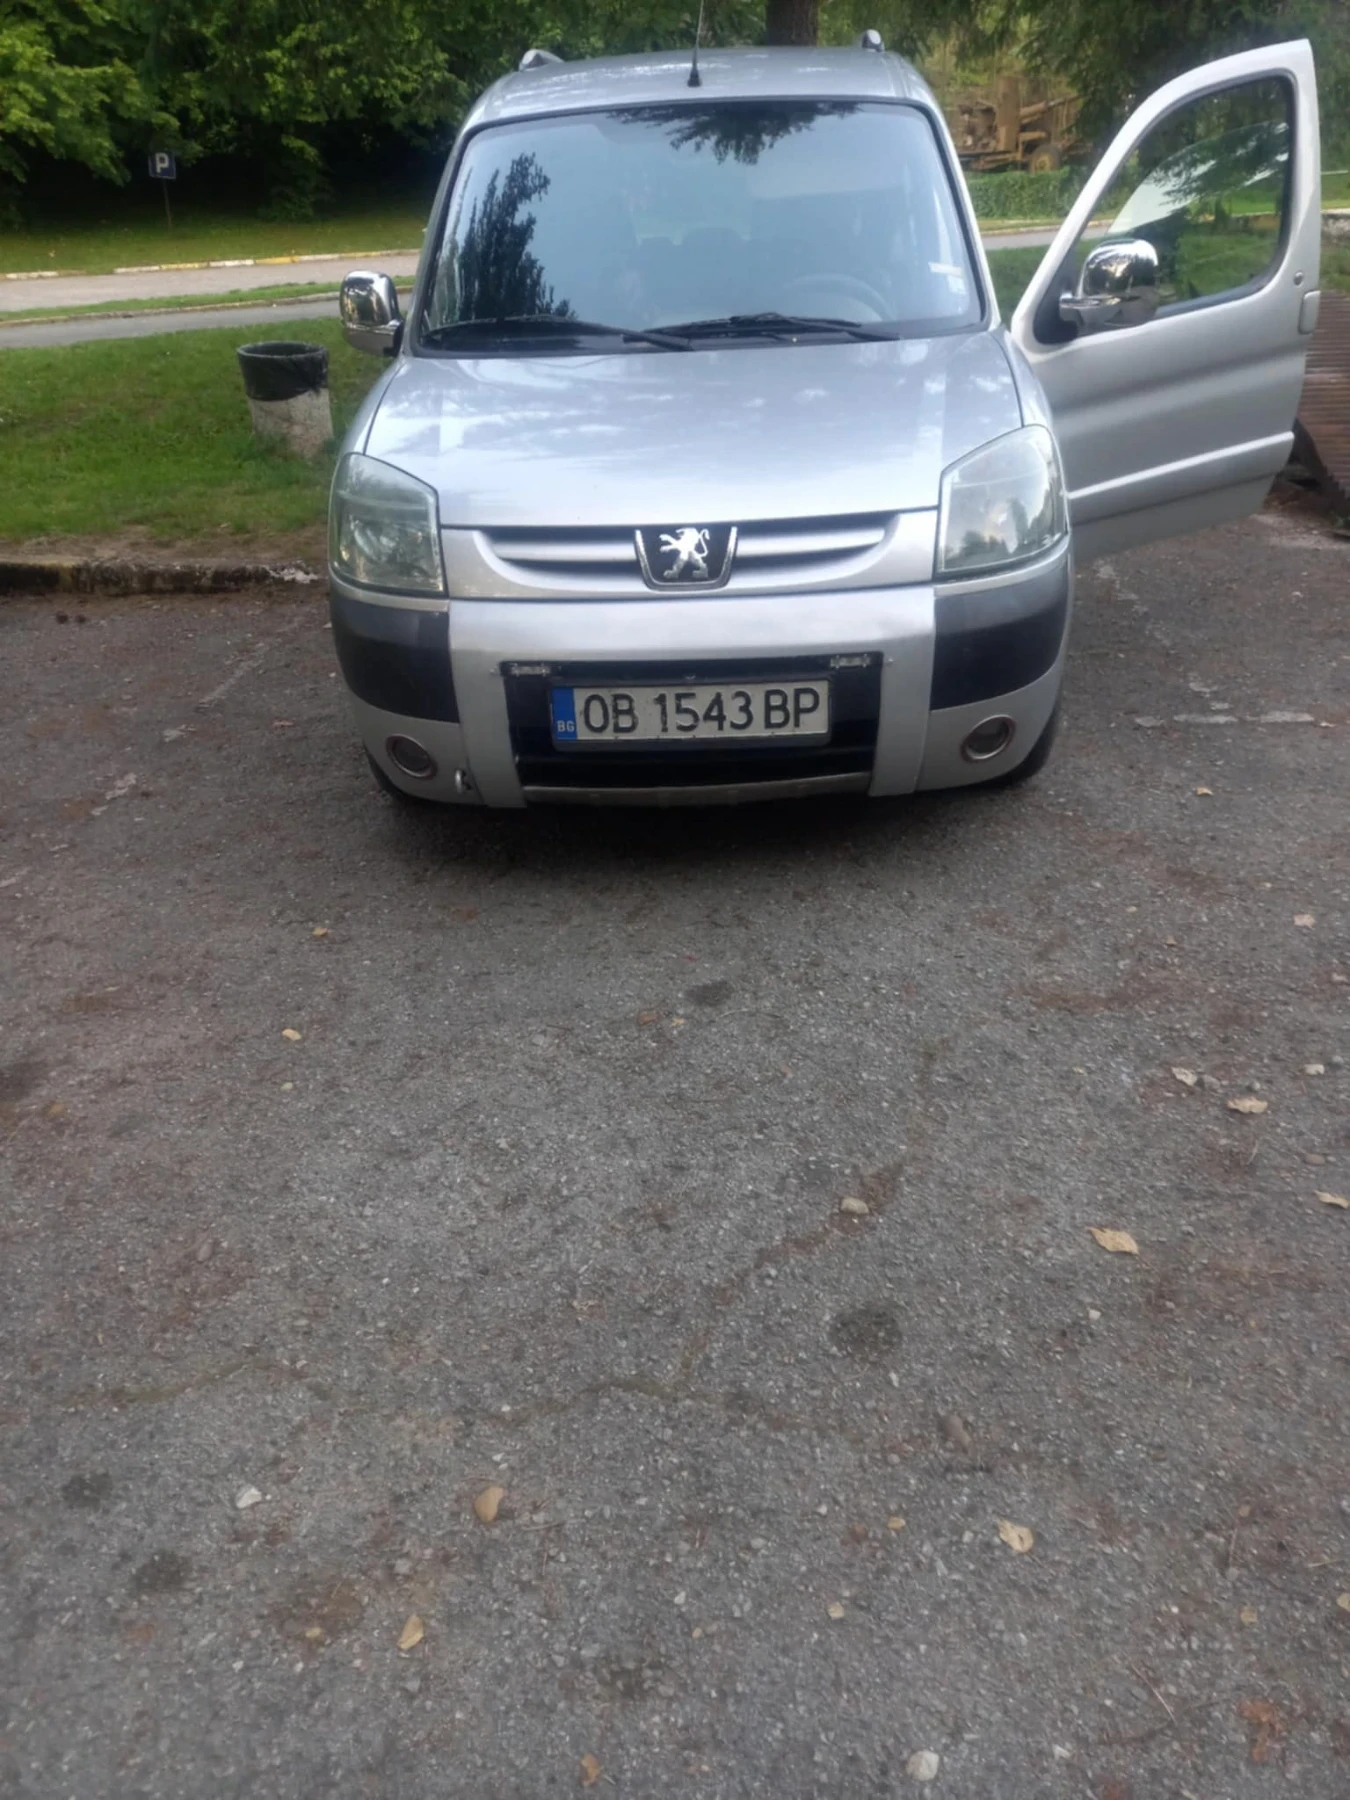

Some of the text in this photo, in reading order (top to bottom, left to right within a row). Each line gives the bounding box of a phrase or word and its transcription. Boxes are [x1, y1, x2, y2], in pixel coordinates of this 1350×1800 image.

[155, 152, 169, 173] P
[583, 687, 820, 733] OB 1543 BP
[557, 721, 575, 733] BG
